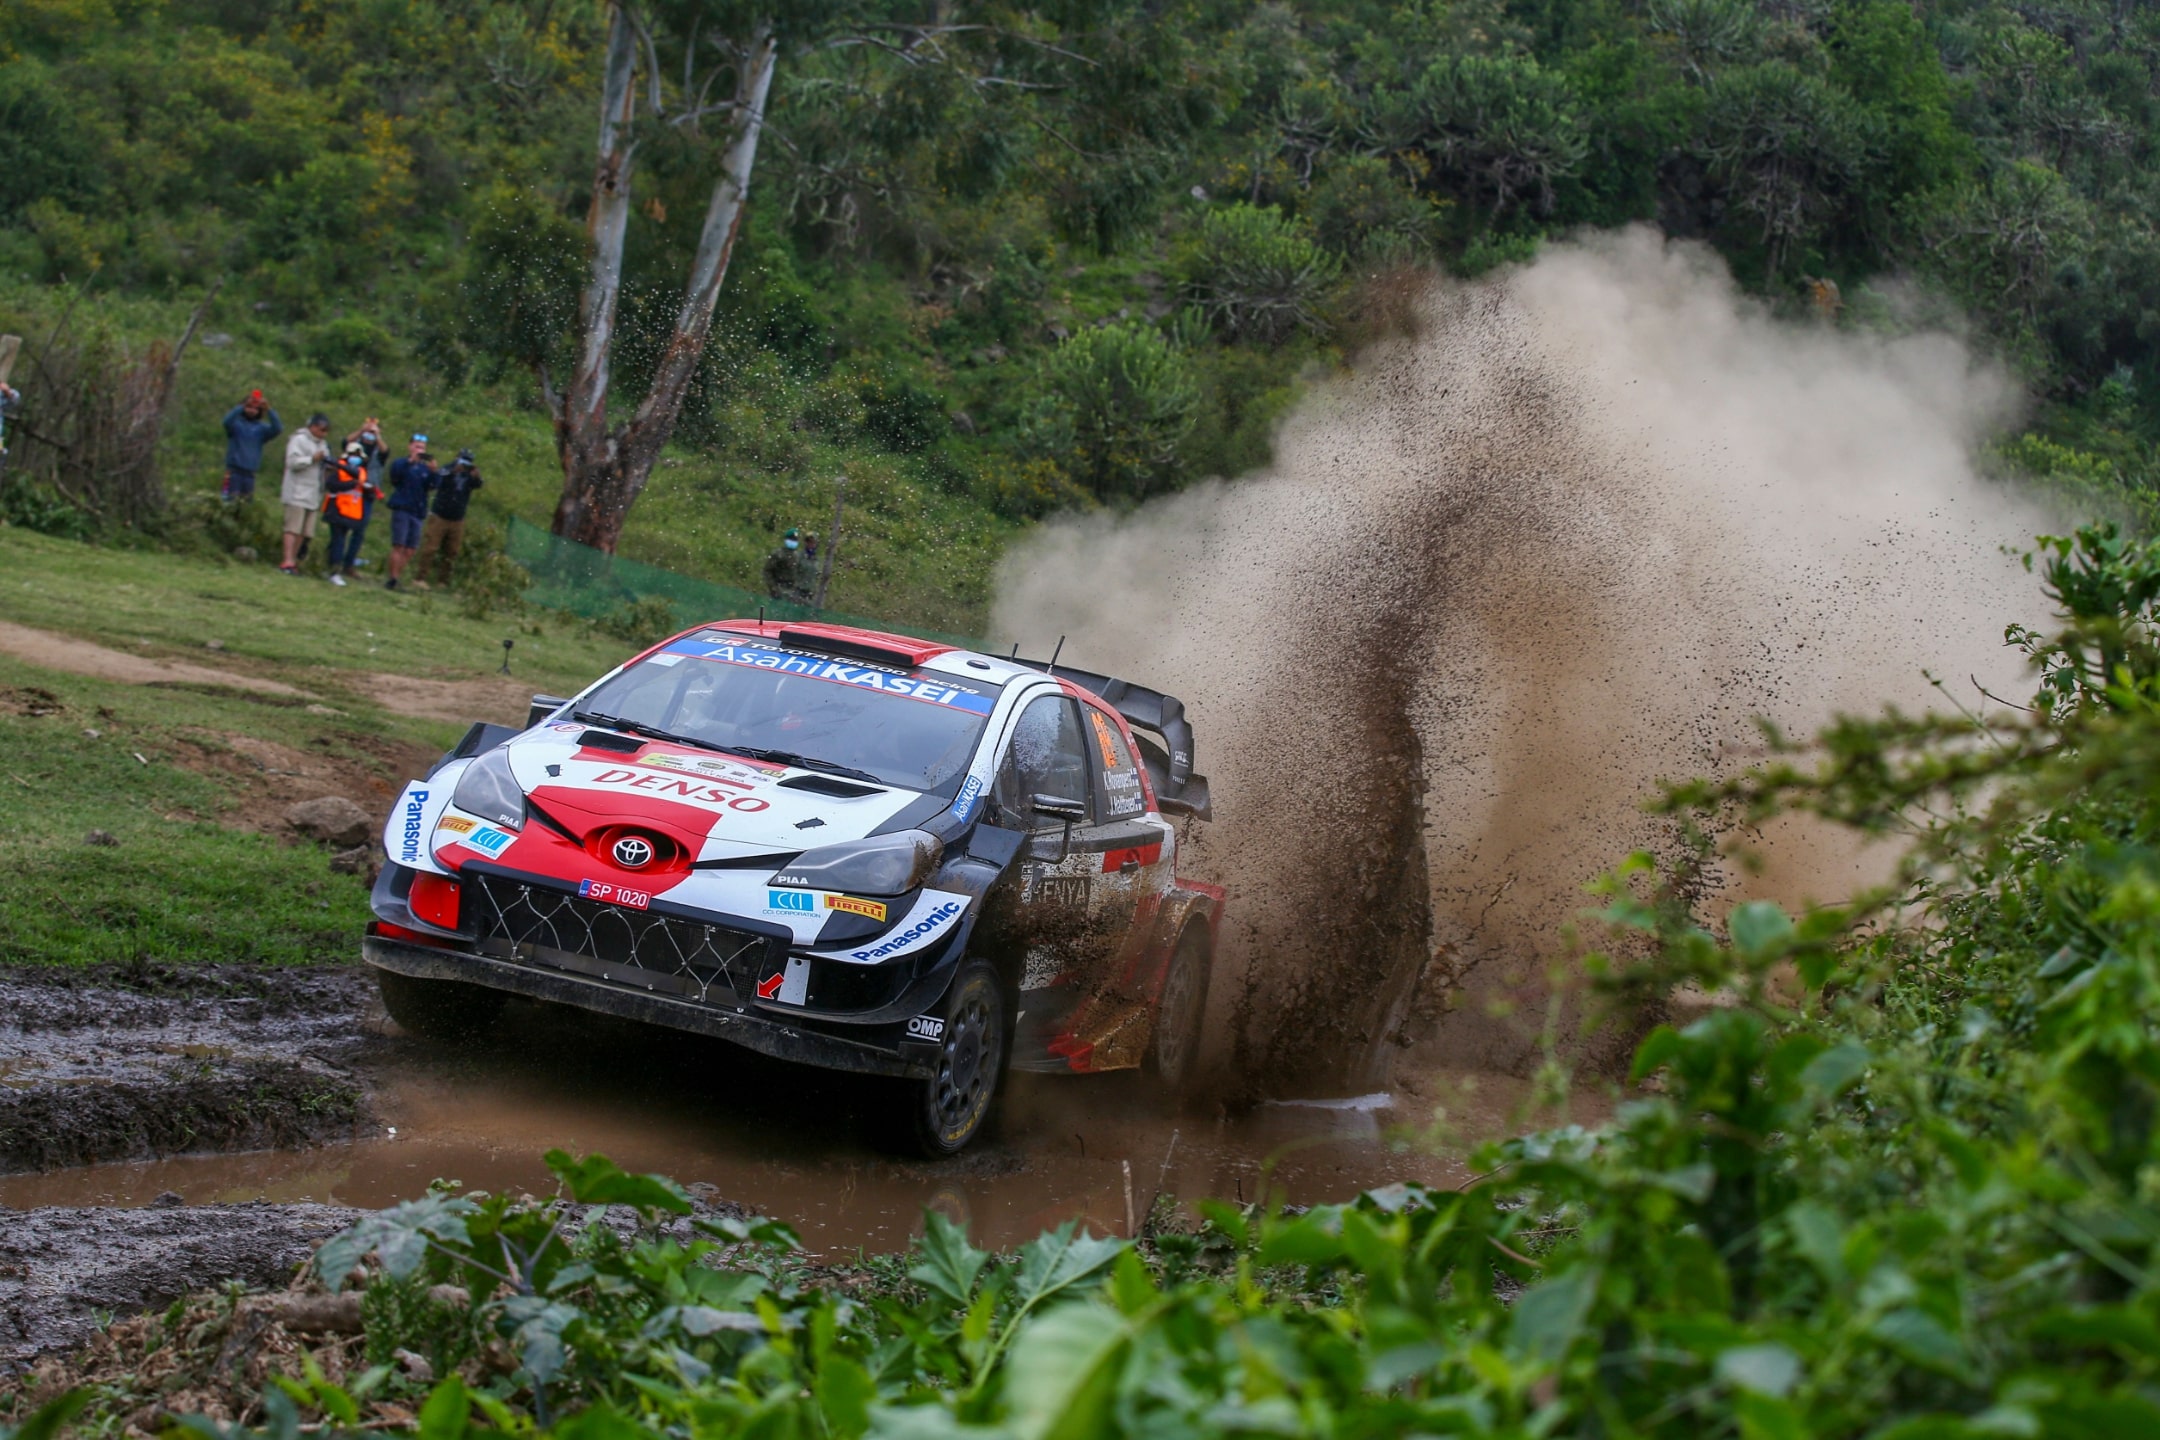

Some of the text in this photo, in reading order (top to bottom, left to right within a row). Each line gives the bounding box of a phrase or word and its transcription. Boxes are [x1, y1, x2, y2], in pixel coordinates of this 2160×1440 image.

[750, 641, 829, 660] TOYOTA
[832, 657, 908, 677] GAZOO
[909, 671, 981, 695] Racing
[592, 769, 770, 813] DENSO
[401, 790, 430, 863] Panasonic
[498, 813, 520, 829] PIAA
[777, 876, 808, 885] PIAA
[590, 883, 647, 907] SP 1020
[776, 909, 822, 919] CORPORATION
[829, 896, 883, 918] PIRELLI
[851, 901, 961, 962] Panasonic
[908, 1017, 944, 1037] OMP
